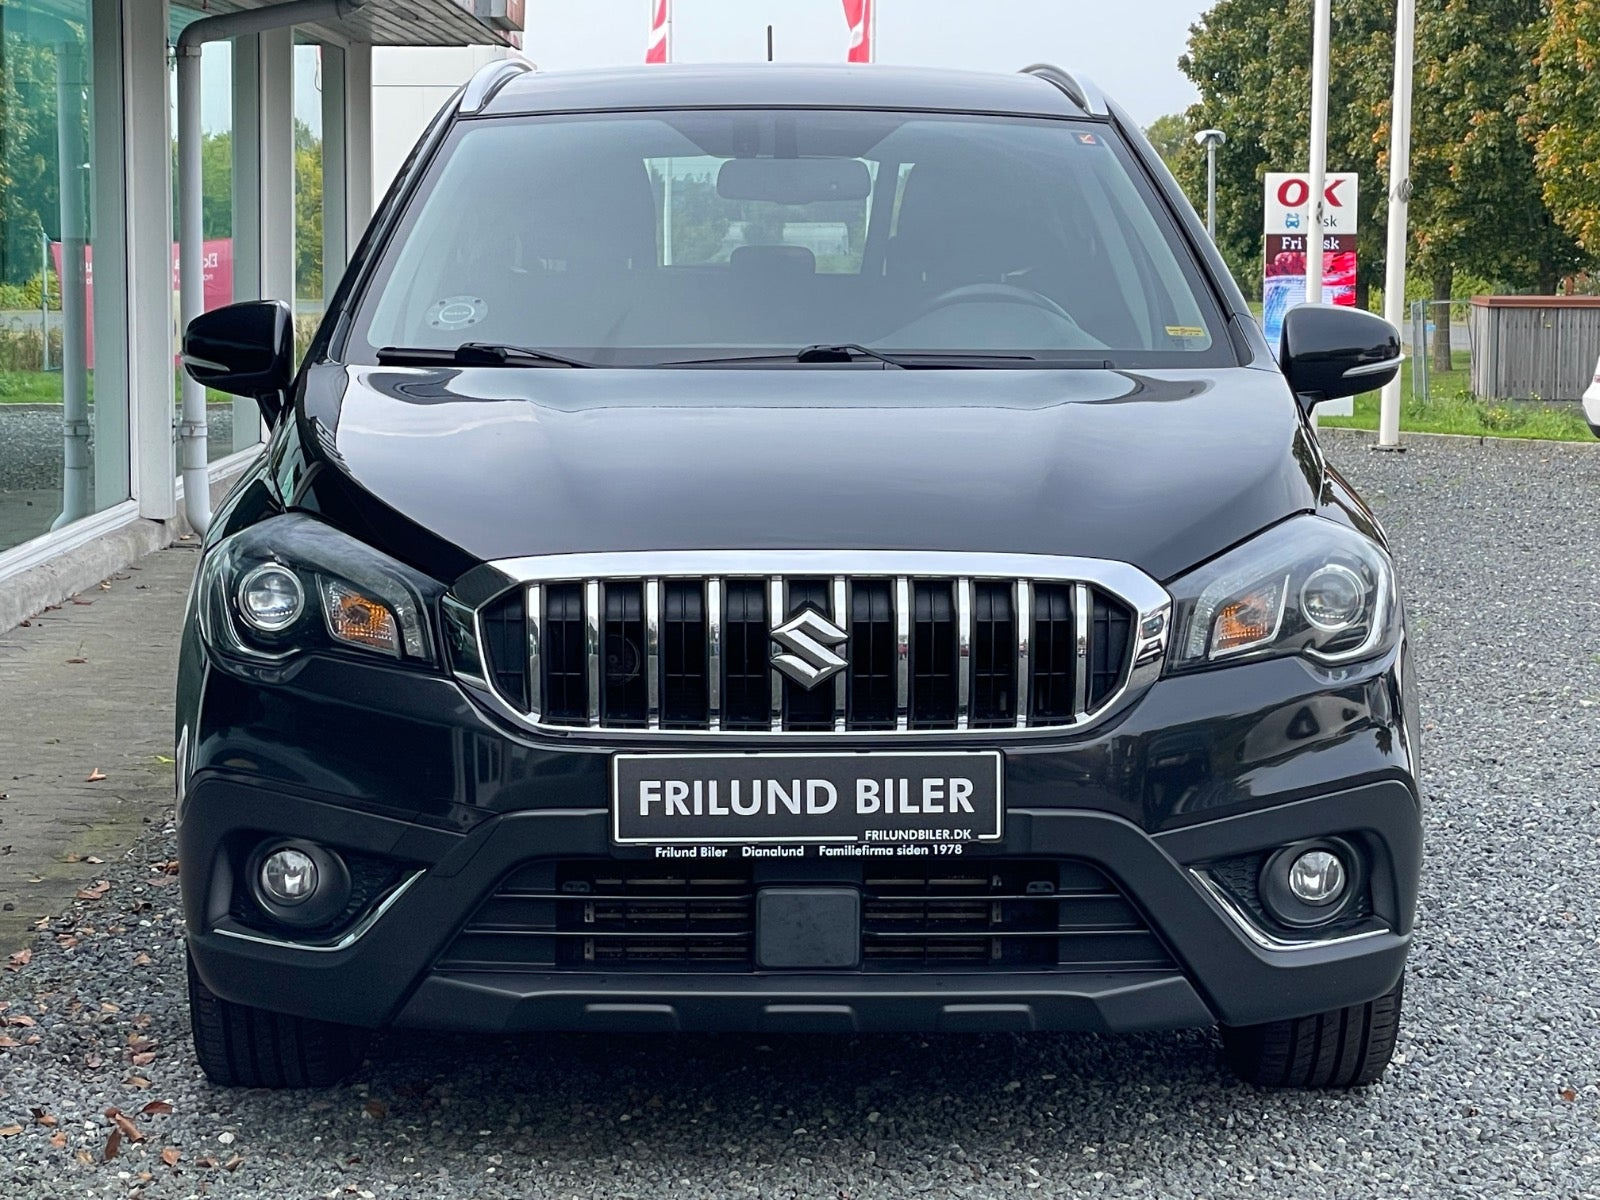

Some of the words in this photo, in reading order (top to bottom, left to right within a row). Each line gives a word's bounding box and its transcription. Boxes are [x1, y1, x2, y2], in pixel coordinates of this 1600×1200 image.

[1281, 236, 1303, 250] Fri
[639, 779, 838, 816] FRILUND
[856, 777, 975, 815] BILER
[864, 828, 972, 841] FRILUNDBILER.DK
[655, 847, 697, 858] Frilund
[700, 847, 728, 858] Biler
[742, 846, 804, 857] Dianalund
[819, 845, 894, 856] Familiefirma
[896, 844, 929, 856] siden
[933, 844, 963, 855] 1978
